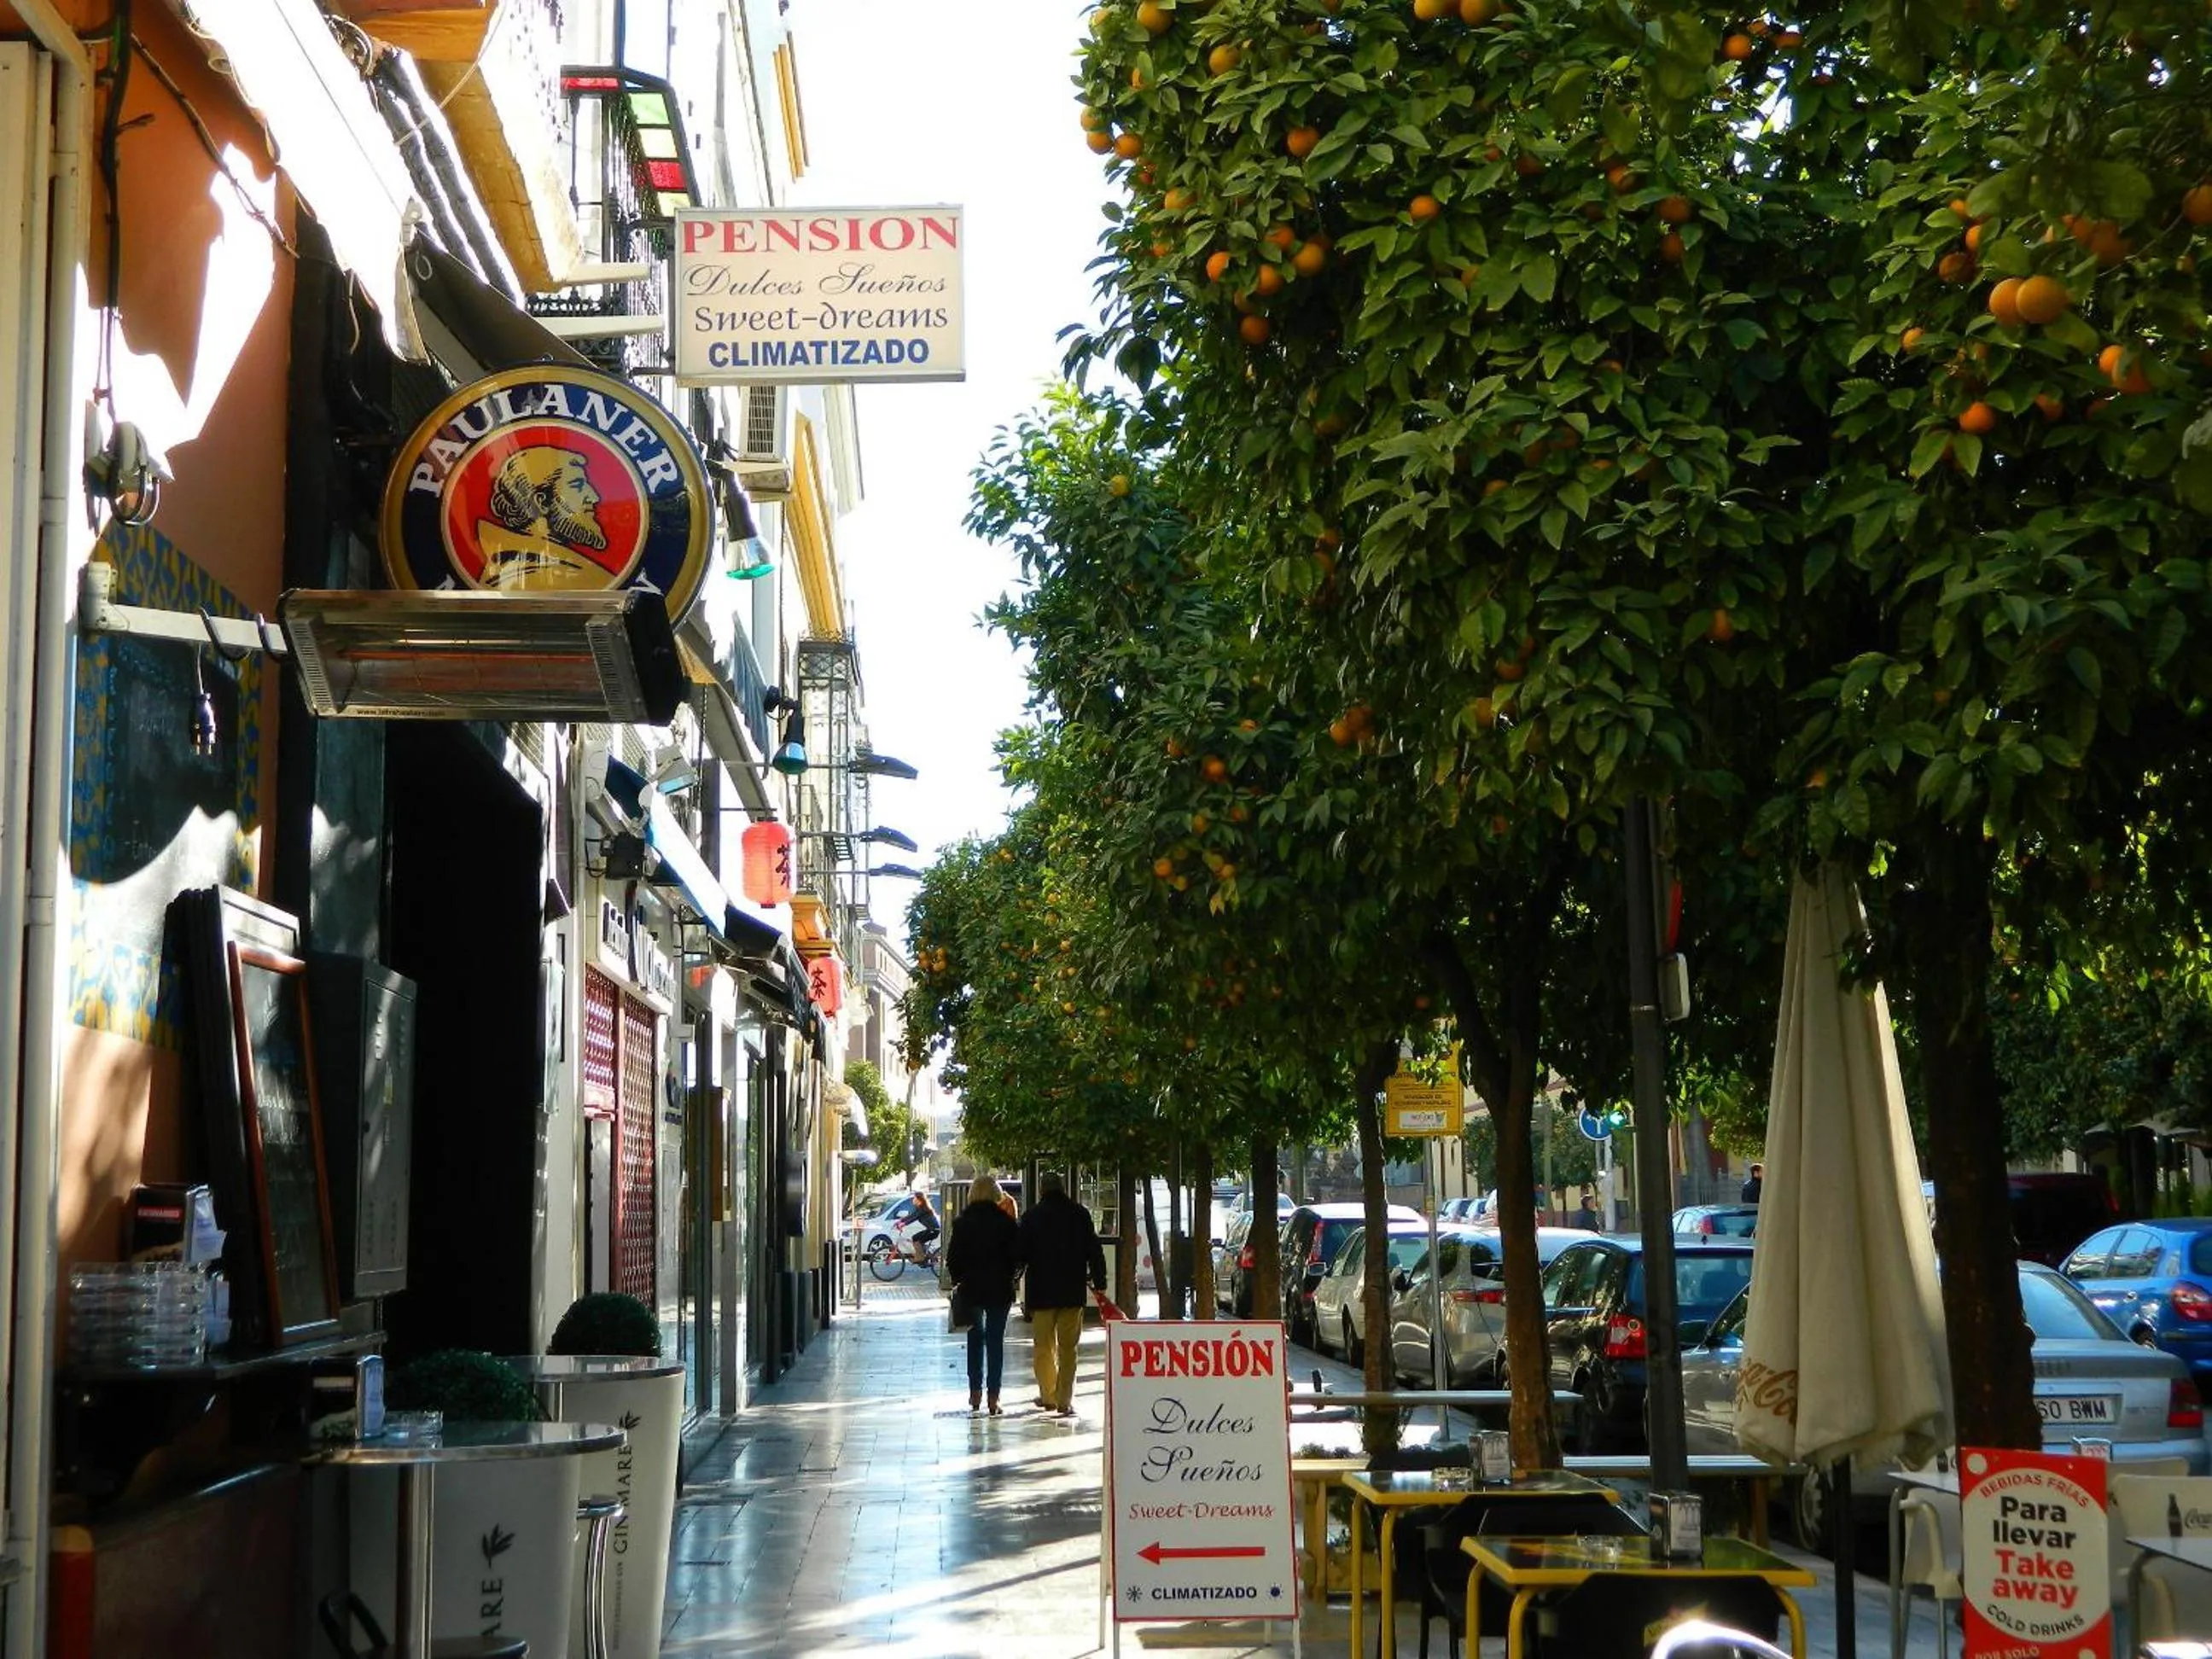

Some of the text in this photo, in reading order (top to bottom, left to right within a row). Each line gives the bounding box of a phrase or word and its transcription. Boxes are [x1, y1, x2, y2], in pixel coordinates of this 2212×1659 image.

[682, 217, 959, 253] PENSION
[683, 262, 946, 295] Dulces Sueños
[695, 302, 947, 331] Sweet-dreams
[708, 339, 929, 368] CLIMATIZADO
[409, 384, 679, 498] PAULANER
[1120, 1330, 1274, 1377] PENSIÓN
[1143, 1397, 1255, 1435] Dulces
[2069, 1400, 2107, 1419] BWM
[1140, 1446, 1265, 1483] Sueños
[614, 1445, 632, 1554] GIN MARE
[1980, 1474, 2043, 1499] BEBIDAS
[1129, 1502, 1275, 1520] Sweet-Dreams
[2000, 1496, 2067, 1523] Para
[1993, 1520, 2076, 1550] llevar
[1994, 1549, 2075, 1580] Take
[1151, 1586, 1258, 1601] CLIMATIZADO
[1993, 1579, 2078, 1610] away
[1987, 1604, 2085, 1636] COLD DRINKS
